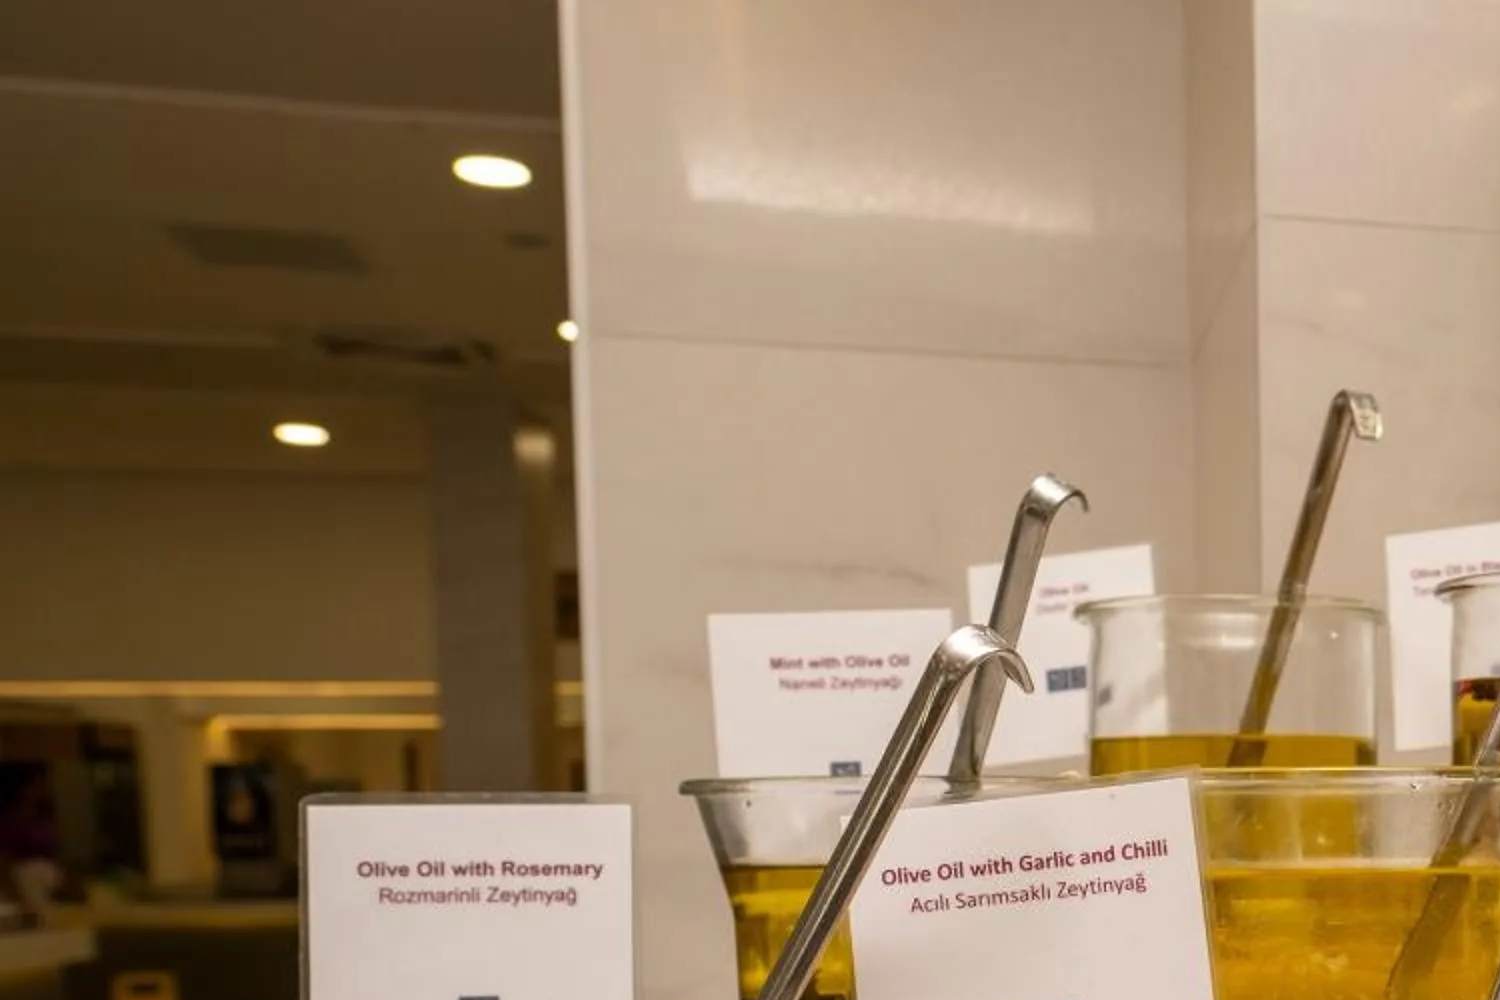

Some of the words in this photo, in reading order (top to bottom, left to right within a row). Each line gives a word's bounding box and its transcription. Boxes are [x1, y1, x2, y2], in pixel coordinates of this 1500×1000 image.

[770, 657, 803, 670] Mint
[808, 656, 841, 669] with
[845, 655, 884, 668] Olive
[888, 653, 910, 668] Oil
[357, 861, 410, 878] Olive
[416, 861, 445, 878] Oil
[451, 861, 495, 878] with
[501, 861, 603, 880] Rosemary
[882, 867, 931, 886] Olive
[937, 861, 964, 880] Oil
[970, 856, 1013, 877] with
[1019, 851, 1074, 872] Garlic
[1080, 845, 1115, 865] and
[1121, 840, 1168, 861] Chilli
[379, 887, 480, 905] Rozmarinli
[486, 886, 577, 907] Zeytinyağ
[1057, 873, 1147, 899] Zeytinyağ
